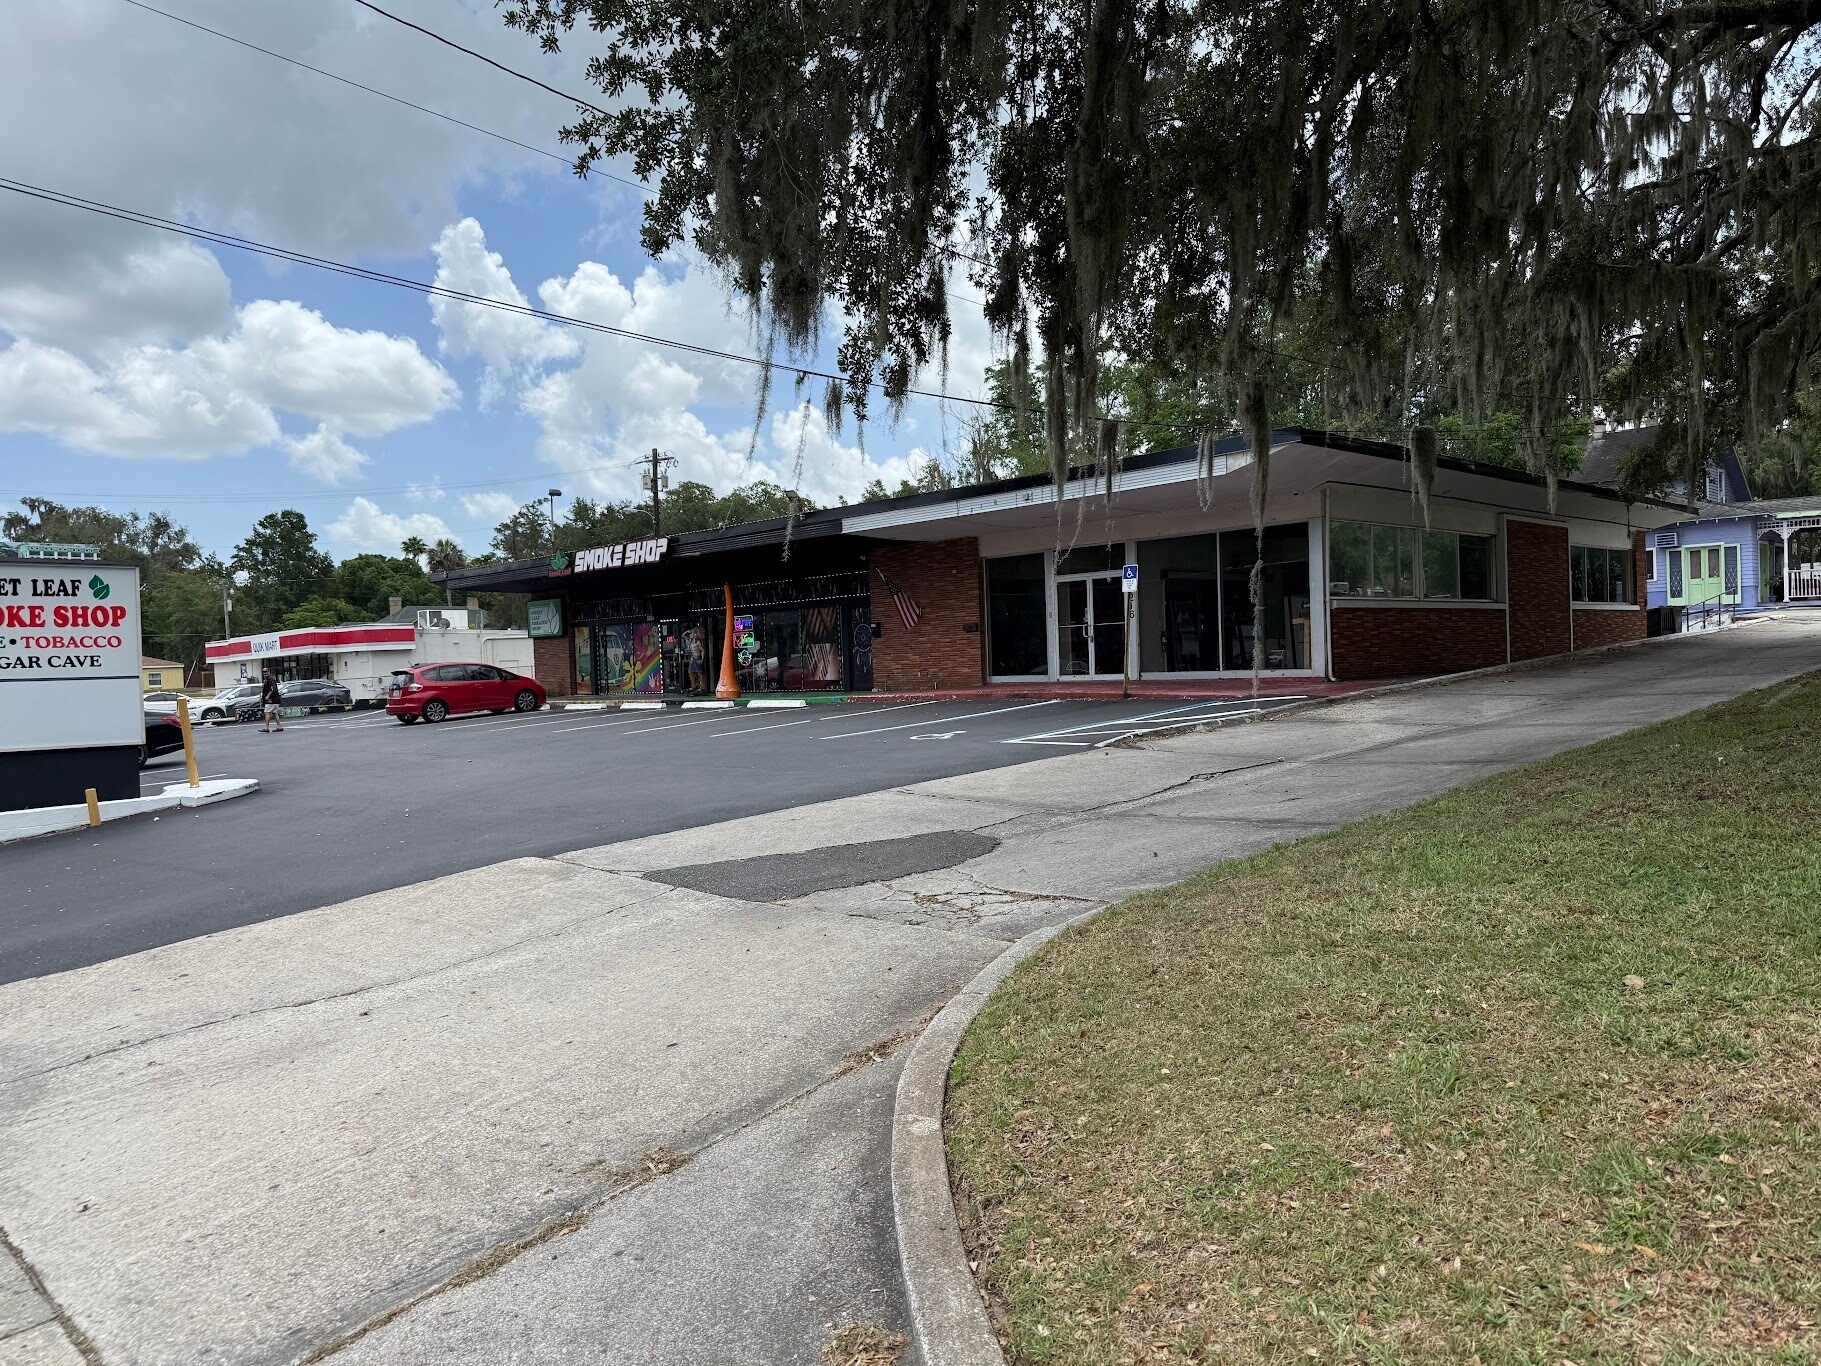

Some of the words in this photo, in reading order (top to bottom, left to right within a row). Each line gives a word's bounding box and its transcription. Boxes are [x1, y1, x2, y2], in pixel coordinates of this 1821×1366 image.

[574, 544, 624, 573] SMOKE
[624, 537, 668, 566] SHOP
[31, 579, 81, 597] LEAF
[0, 605, 45, 628] KE
[53, 605, 126, 628] SHOP
[20, 635, 122, 649] TOBACCO
[265, 640, 277, 651] MART
[0, 656, 42, 669] GAR
[47, 655, 102, 668] CAVE
